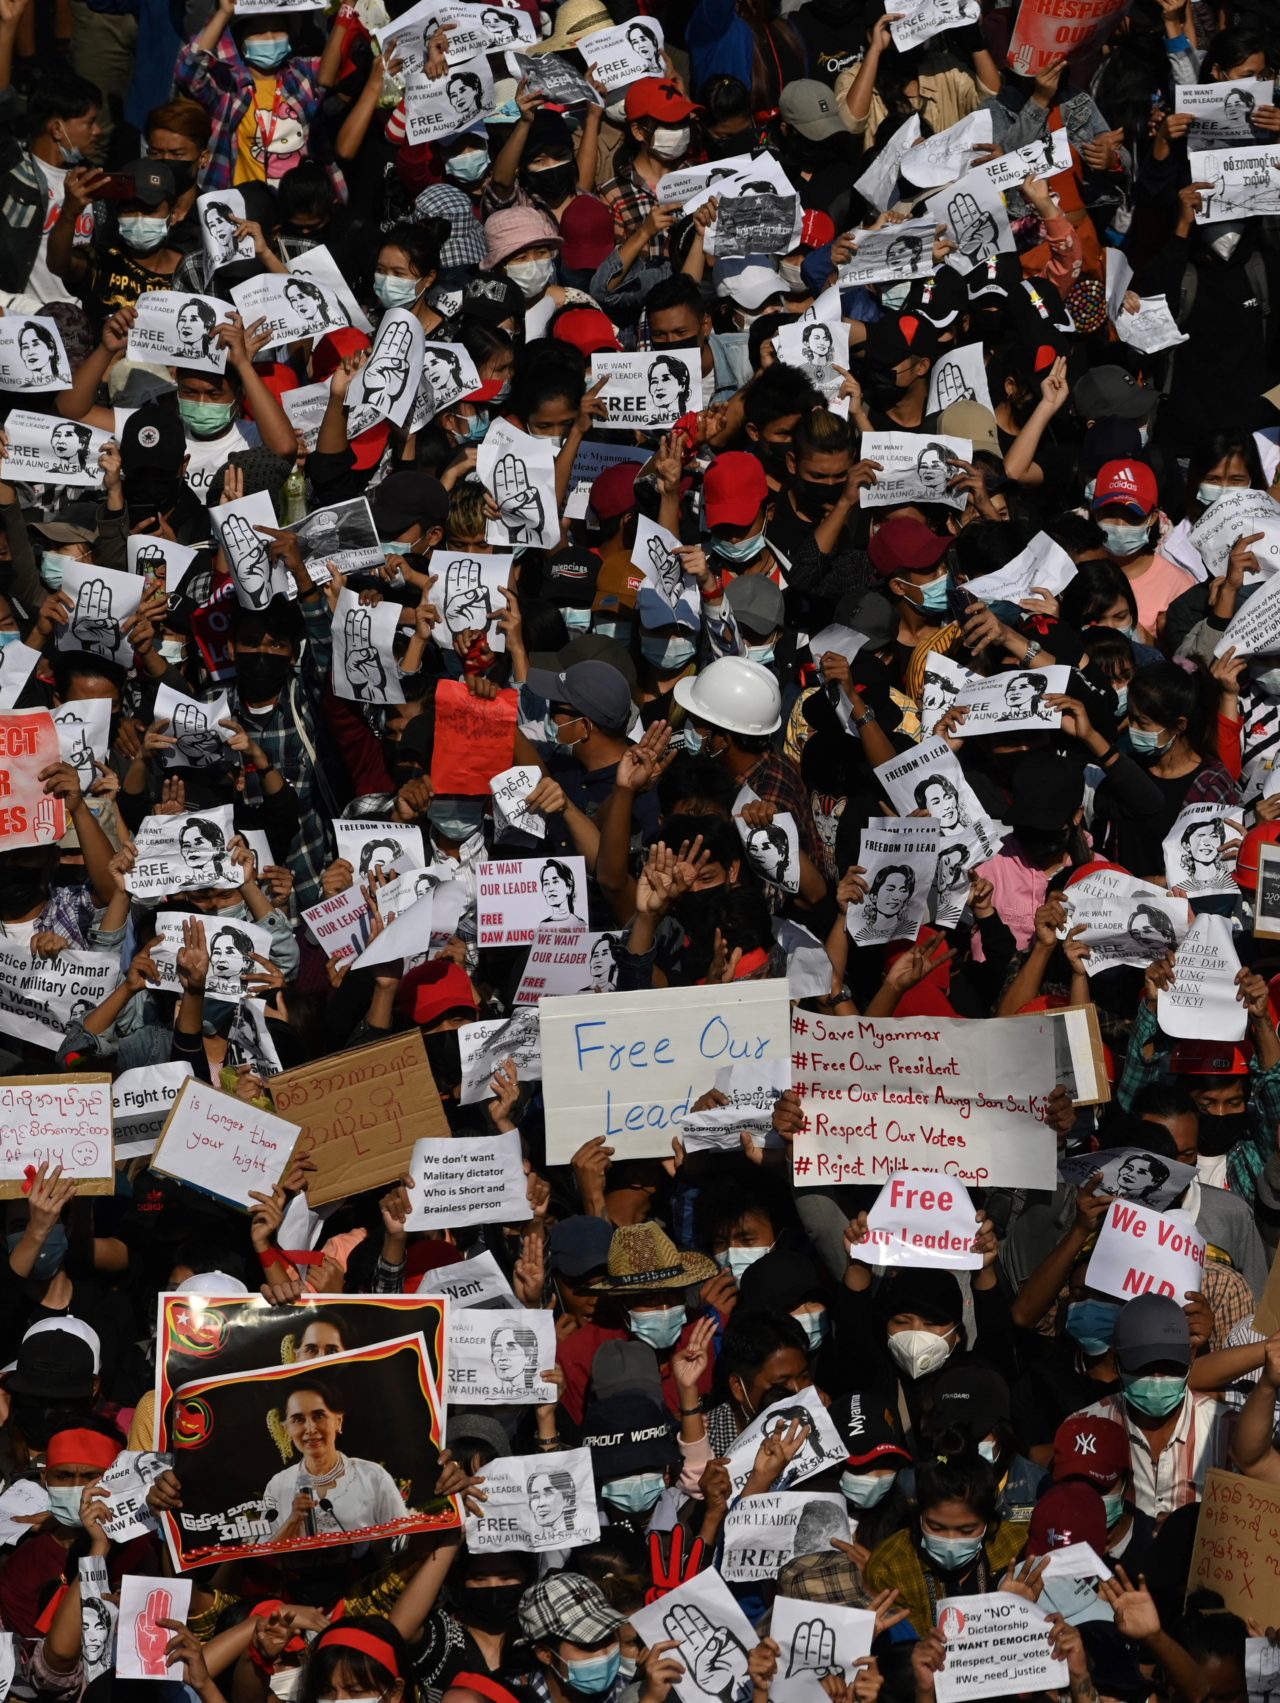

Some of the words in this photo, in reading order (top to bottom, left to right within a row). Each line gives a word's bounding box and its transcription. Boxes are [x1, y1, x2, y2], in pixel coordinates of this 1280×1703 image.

[447, 31, 477, 46] FREE
[597, 58, 630, 76] FREE
[410, 112, 443, 128] FREE
[609, 362, 632, 370] WANT
[1109, 479, 1138, 491] adidas
[1250, 632, 1264, 644] We
[885, 761, 918, 782] FREEDOM
[919, 755, 931, 766] TO
[932, 744, 949, 759] LEAD
[865, 840, 900, 853] FREEDOM
[903, 841, 914, 852] TO
[916, 840, 936, 852] LEAD
[479, 863, 491, 875] WE
[494, 862, 522, 875] WANT
[131, 877, 154, 889] DAW
[156, 875, 183, 887] AUNG
[480, 883, 500, 896] OUR
[503, 881, 538, 895] LEADER
[481, 913, 503, 926] FREE
[481, 931, 509, 943] DAW
[511, 930, 534, 942] AUNG
[31, 957, 46, 970] for
[51, 958, 110, 978] Myanmar
[21, 975, 67, 994] Military
[71, 981, 105, 1000] Coup
[858, 1022, 940, 1048] Myanmar
[575, 1021, 675, 1072] Free
[700, 1017, 771, 1060] Our
[850, 1052, 881, 1071] Our
[889, 1056, 960, 1075] President
[124, 1086, 158, 1108] Fight
[848, 1083, 878, 1102] Our
[882, 1085, 929, 1105] Leader
[935, 1085, 970, 1119] Aung
[975, 1092, 1003, 1109] San
[1006, 1097, 1027, 1113] Su
[189, 1097, 199, 1111] is
[249, 1128, 277, 1151] than
[886, 1121, 915, 1141] Our
[920, 1126, 966, 1148] Votes
[232, 1146, 267, 1172] hight
[424, 1156, 440, 1164] We
[442, 1154, 467, 1164] don't
[470, 1154, 495, 1162] want
[424, 1171, 464, 1181] Malitary
[466, 1168, 504, 1178] dictator
[424, 1189, 446, 1198] Who
[449, 1188, 457, 1196] is
[459, 1186, 485, 1195] Short
[487, 1183, 505, 1193] and
[890, 1179, 954, 1213] Free
[424, 1204, 467, 1214] Brainless
[469, 1201, 501, 1212] person
[1110, 1203, 1147, 1238] We
[1158, 1220, 1207, 1269] Voted
[749, 1497, 781, 1509] WANT
[477, 1518, 519, 1531] FREE
[728, 1514, 752, 1526] OUR
[755, 1514, 797, 1526] LEADER
[963, 1611, 982, 1623] Say
[984, 1605, 1017, 1619] "NO"
[1019, 1606, 1028, 1615] to
[968, 1619, 1029, 1637] Dictatorship
[959, 1639, 989, 1651] WANT
[992, 1632, 1051, 1647] DEMOCRAC
